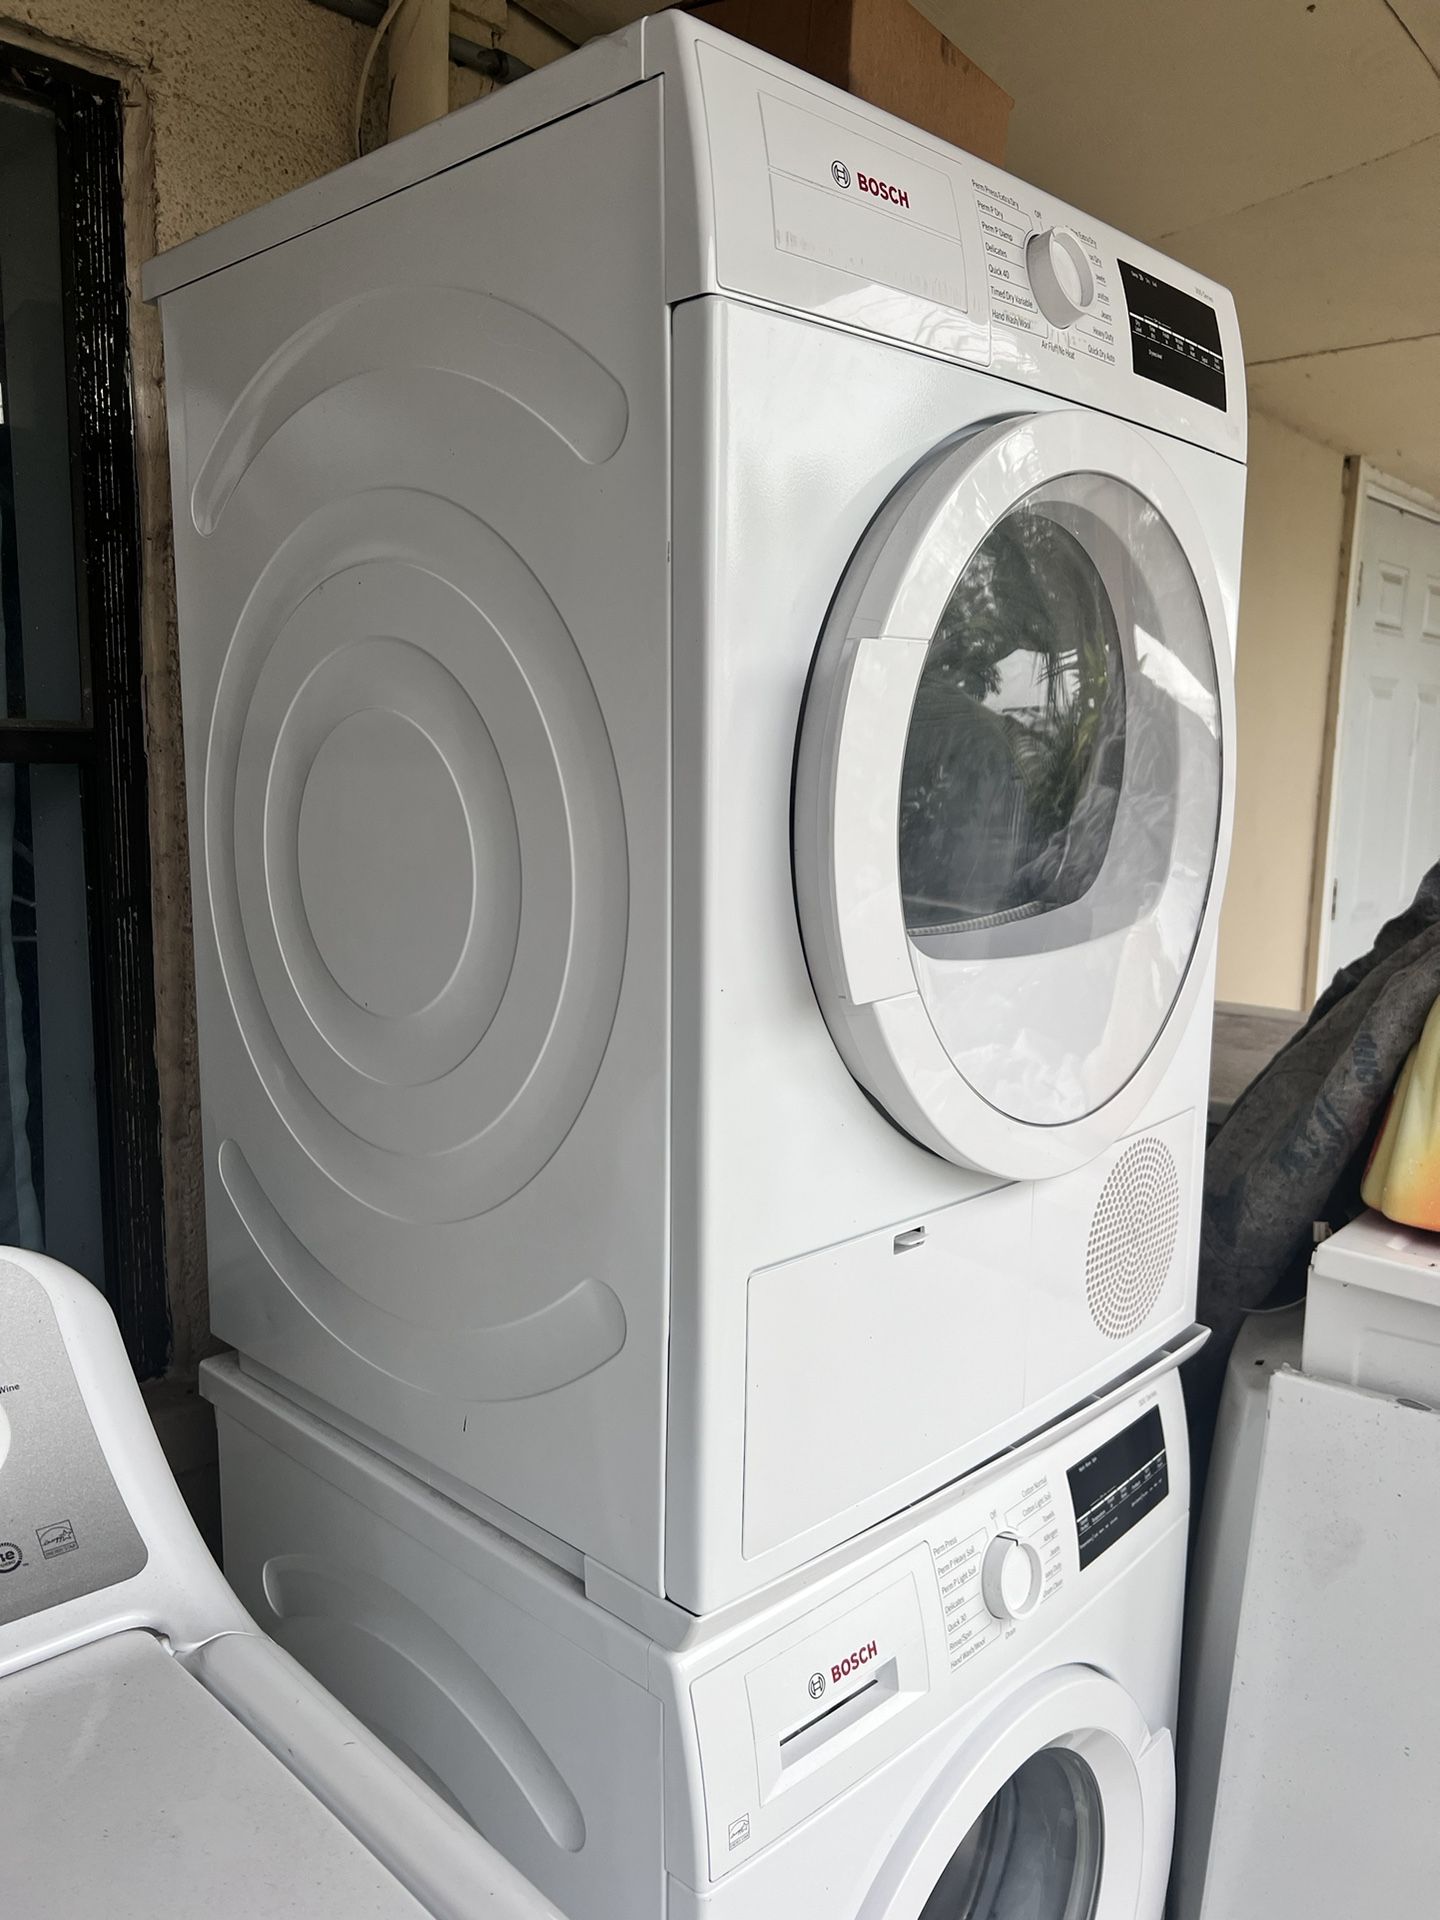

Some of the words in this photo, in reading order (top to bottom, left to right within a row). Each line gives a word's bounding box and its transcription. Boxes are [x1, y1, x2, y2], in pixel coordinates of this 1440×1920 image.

[857, 172, 910, 209] BOSCH
[981, 221, 993, 232] Perm
[985, 241, 1008, 258] Delicates
[988, 263, 1002, 276] Quick
[1003, 269, 1010, 279] 40
[990, 285, 1005, 299] Timed
[1005, 291, 1015, 304] Dry
[1015, 295, 1033, 309] Variable
[992, 309, 1005, 322] Hand
[933, 1543, 945, 1556] Perm
[937, 1563, 949, 1576] Perm
[941, 1582, 954, 1596] Perm
[947, 1618, 960, 1632] Quick
[831, 1640, 878, 1683] BOSCH
